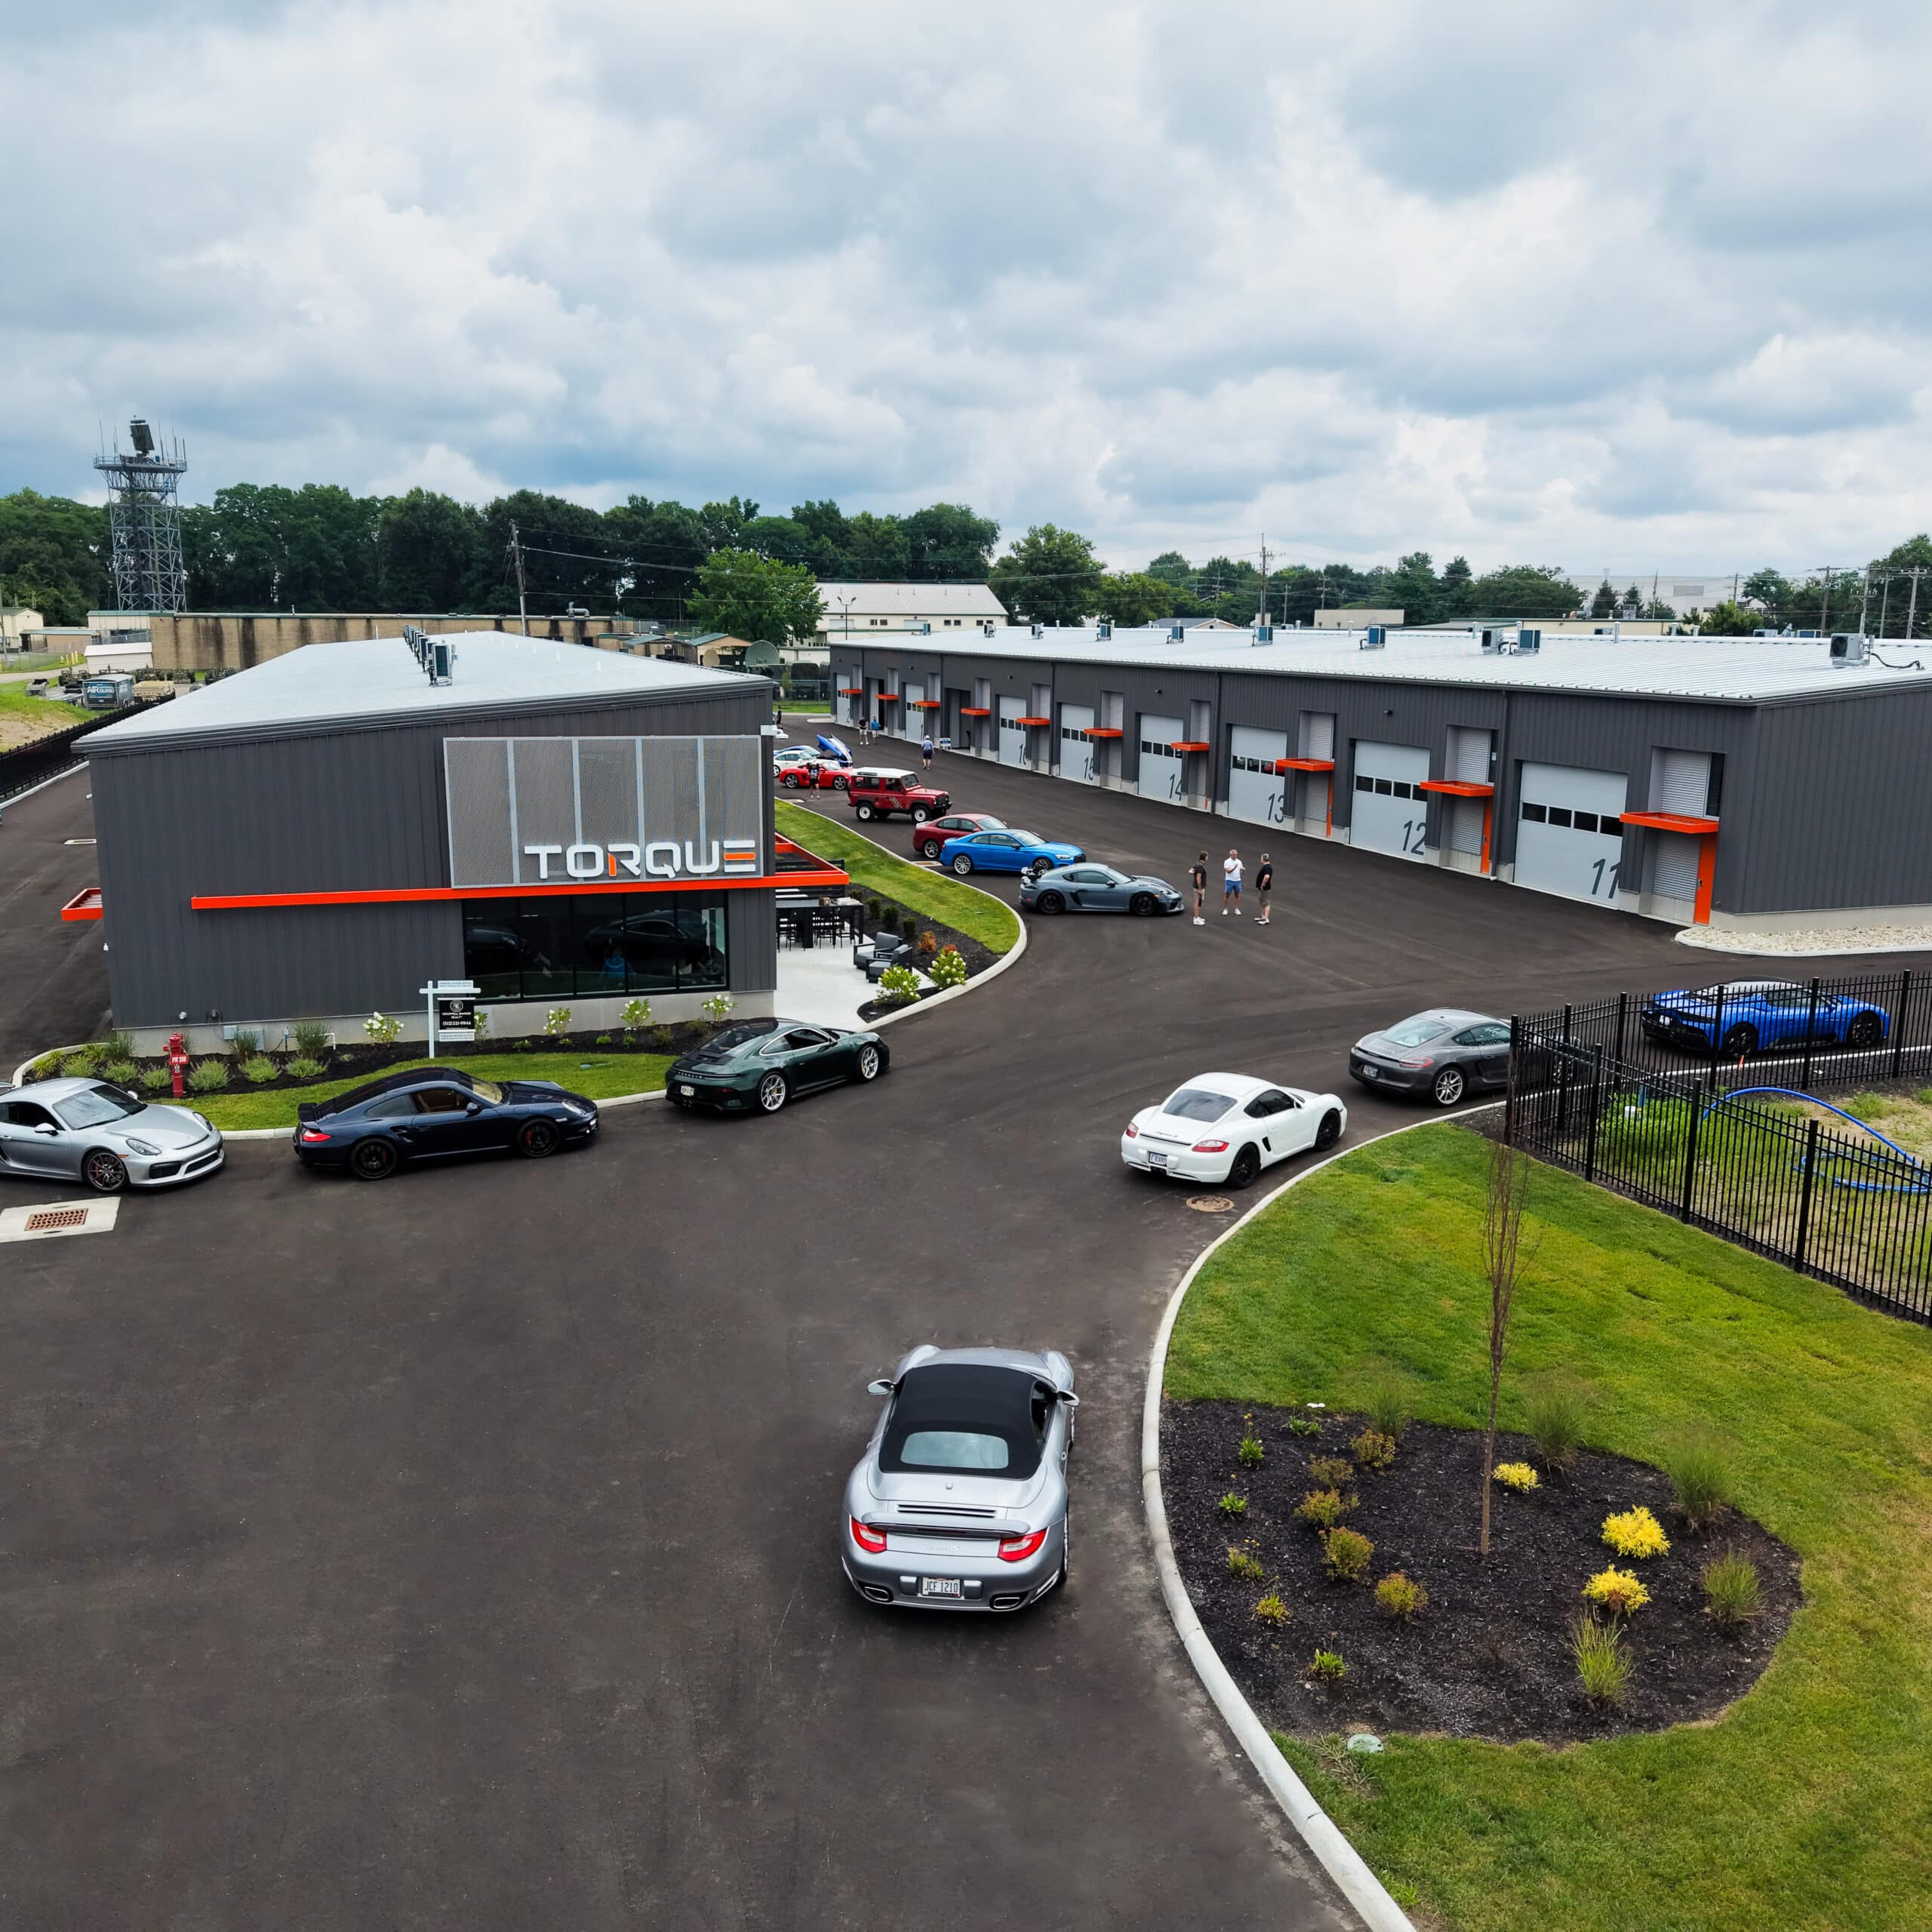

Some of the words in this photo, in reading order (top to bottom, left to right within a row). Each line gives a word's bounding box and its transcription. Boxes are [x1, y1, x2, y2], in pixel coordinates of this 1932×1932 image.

[1170, 774, 1182, 801] 14
[1267, 792, 1284, 823] 13
[1402, 820, 1426, 856] 12
[525, 839, 756, 879] TORQUE
[1591, 858, 1620, 900] 11
[924, 1581, 937, 1591] JCF
[940, 1582, 958, 1592] 1210
